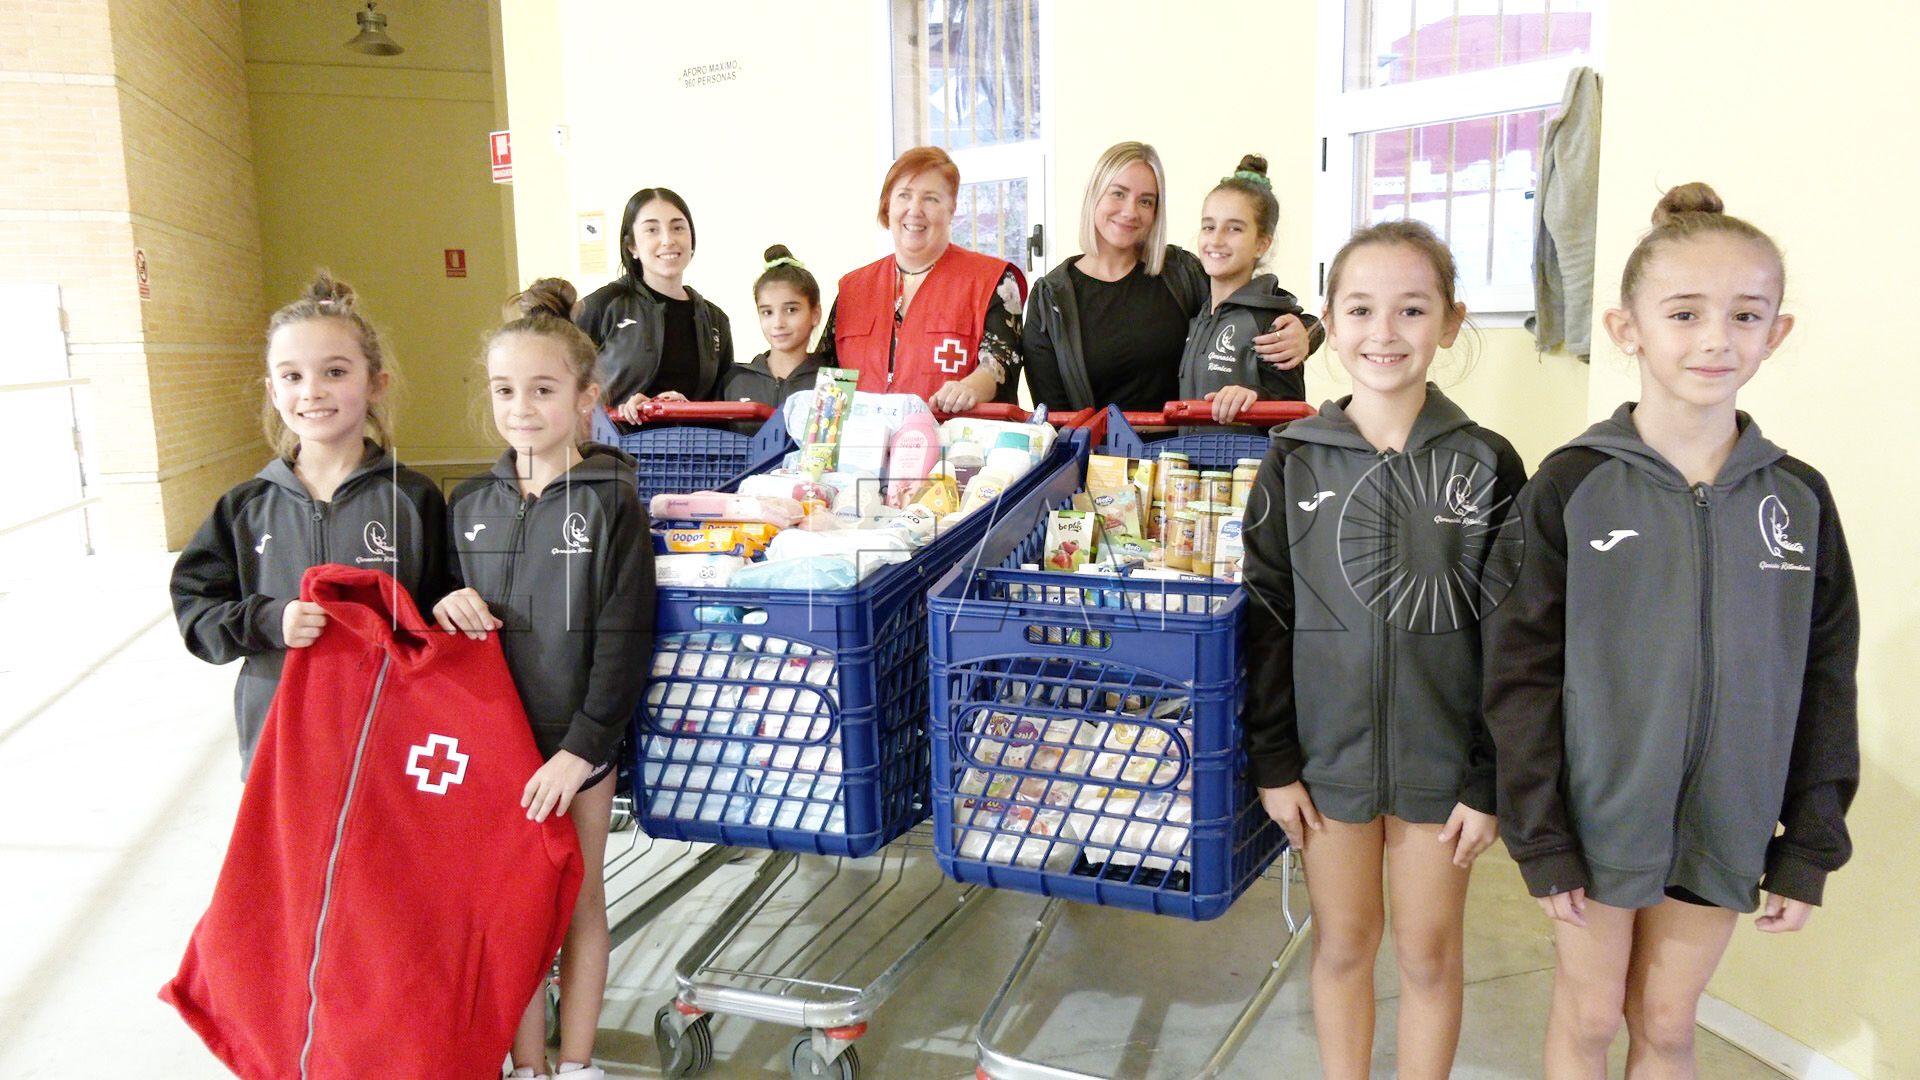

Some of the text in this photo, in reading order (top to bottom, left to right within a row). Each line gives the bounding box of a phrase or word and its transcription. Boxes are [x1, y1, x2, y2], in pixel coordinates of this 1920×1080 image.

[683, 66, 708, 77] AFORO
[697, 71, 737, 86] PERSONAS
[672, 533, 704, 543] DODOT
